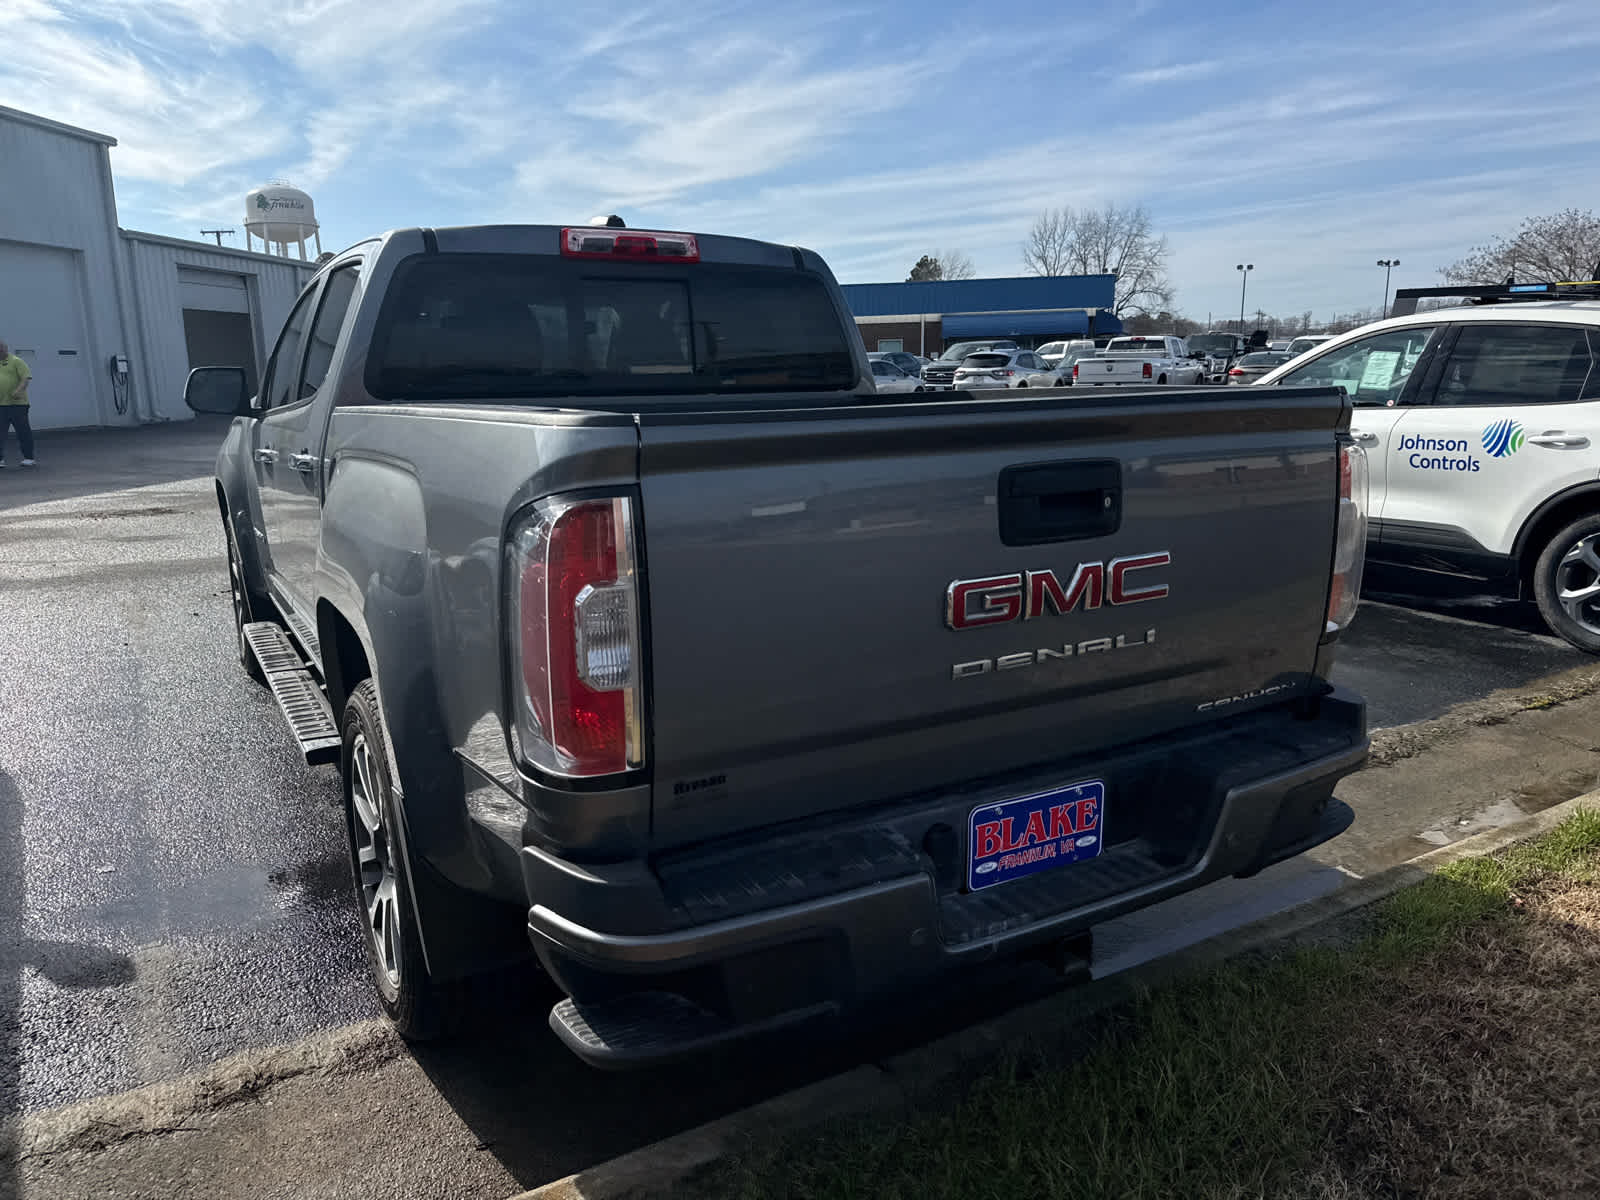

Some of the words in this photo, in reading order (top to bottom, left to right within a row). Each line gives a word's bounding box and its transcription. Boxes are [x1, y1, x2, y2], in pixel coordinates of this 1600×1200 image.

[1398, 434, 1468, 452] Johnson
[1409, 453, 1480, 472] Controls
[947, 551, 1171, 630] GMC
[952, 628, 1156, 680] DENALI
[975, 797, 1099, 860] BLAKE
